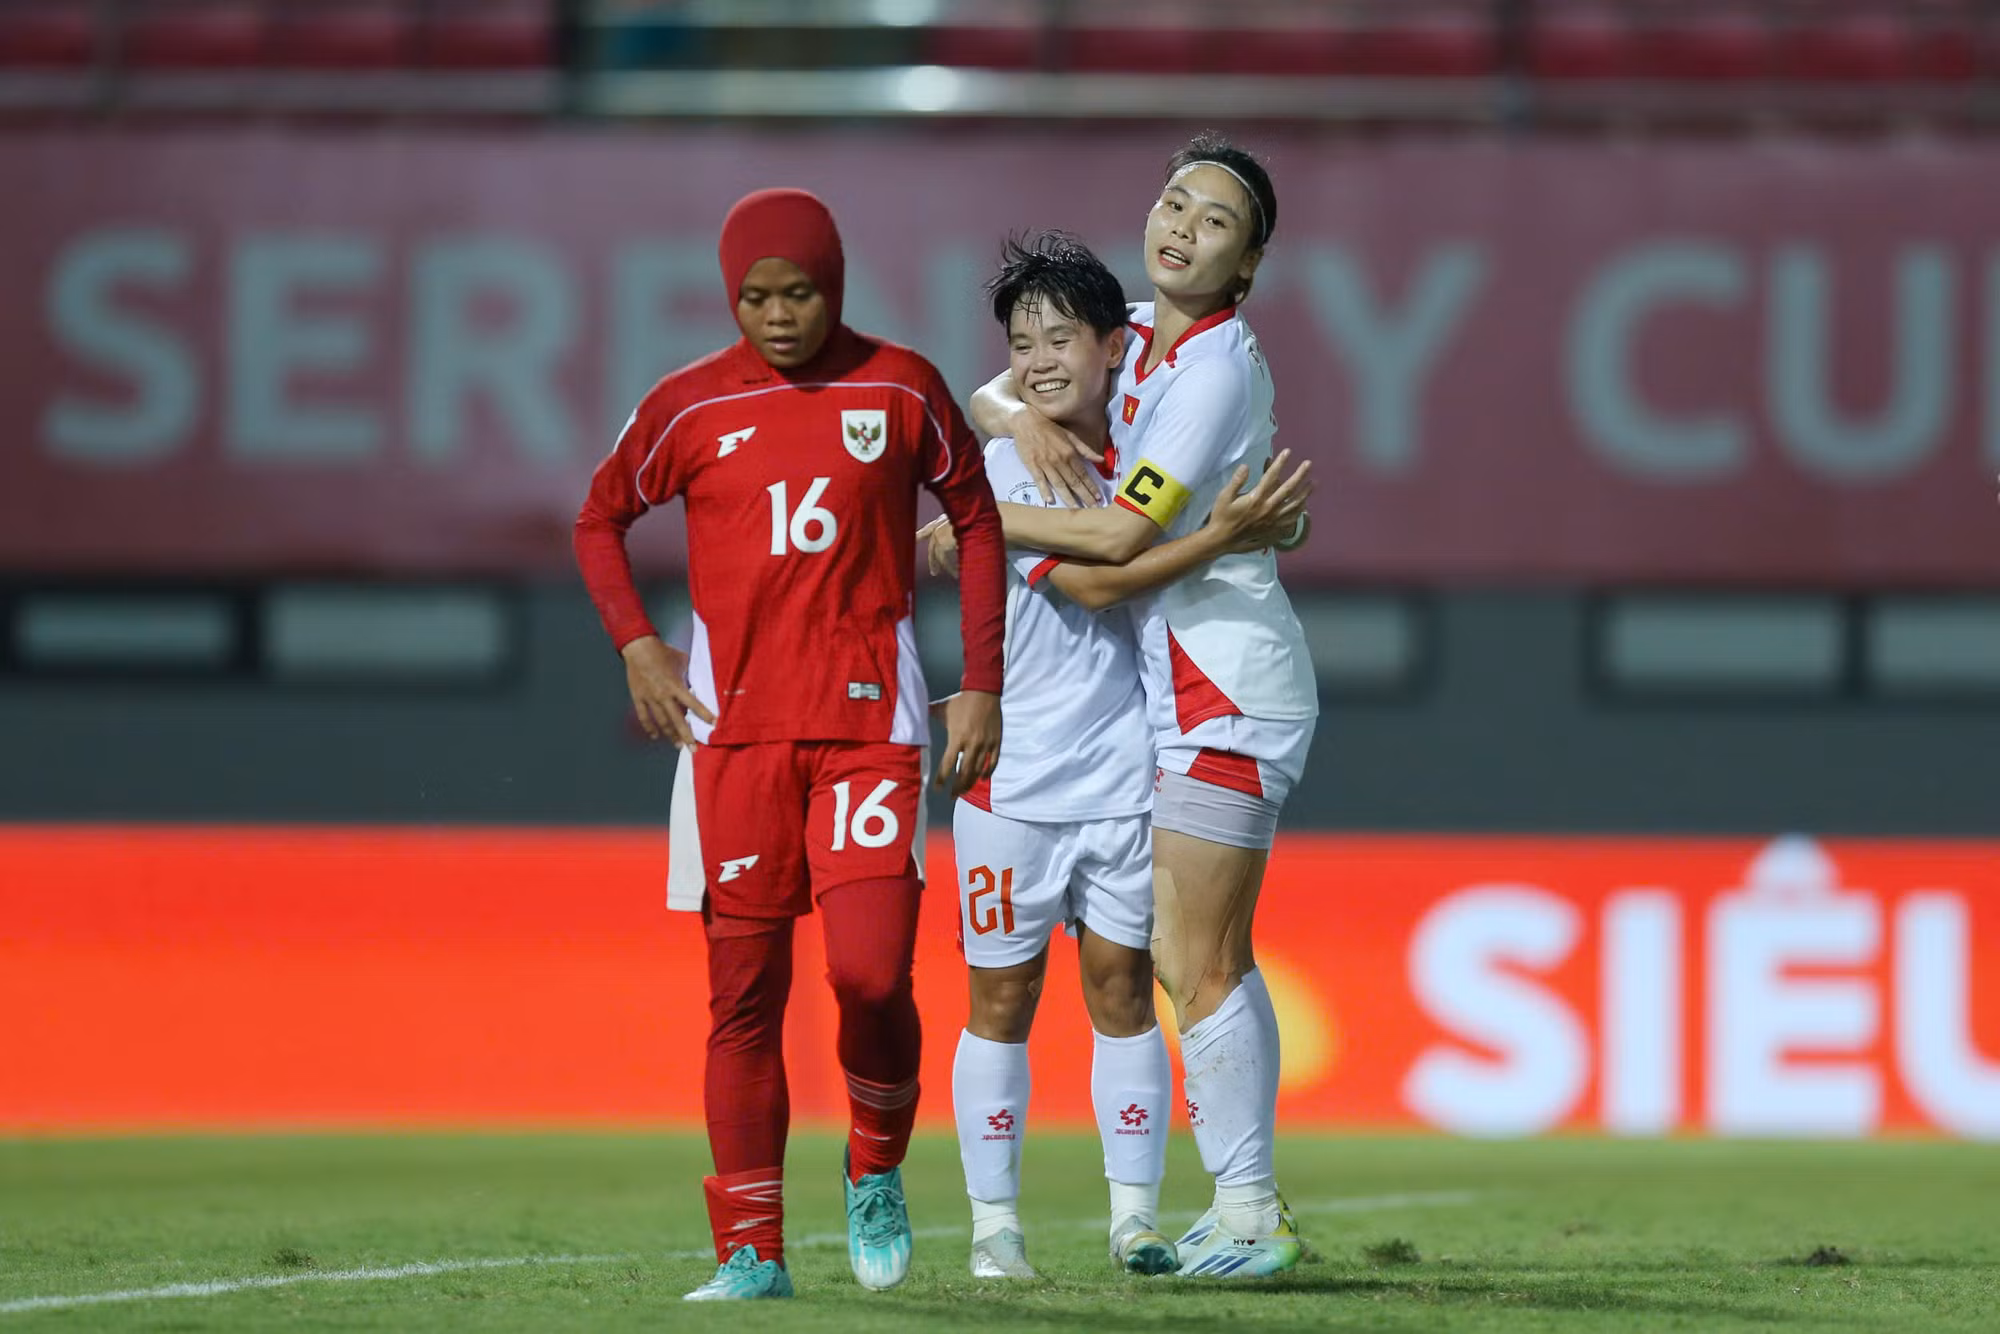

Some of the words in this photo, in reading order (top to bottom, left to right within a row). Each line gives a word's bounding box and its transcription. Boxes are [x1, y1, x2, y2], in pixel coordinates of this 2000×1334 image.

[1564, 235, 2000, 484] CU
[766, 476, 838, 556] 16
[1125, 465, 1164, 505] C
[831, 778, 899, 852] 16
[968, 864, 1015, 935] 21
[1233, 1238, 1246, 1246] HY
